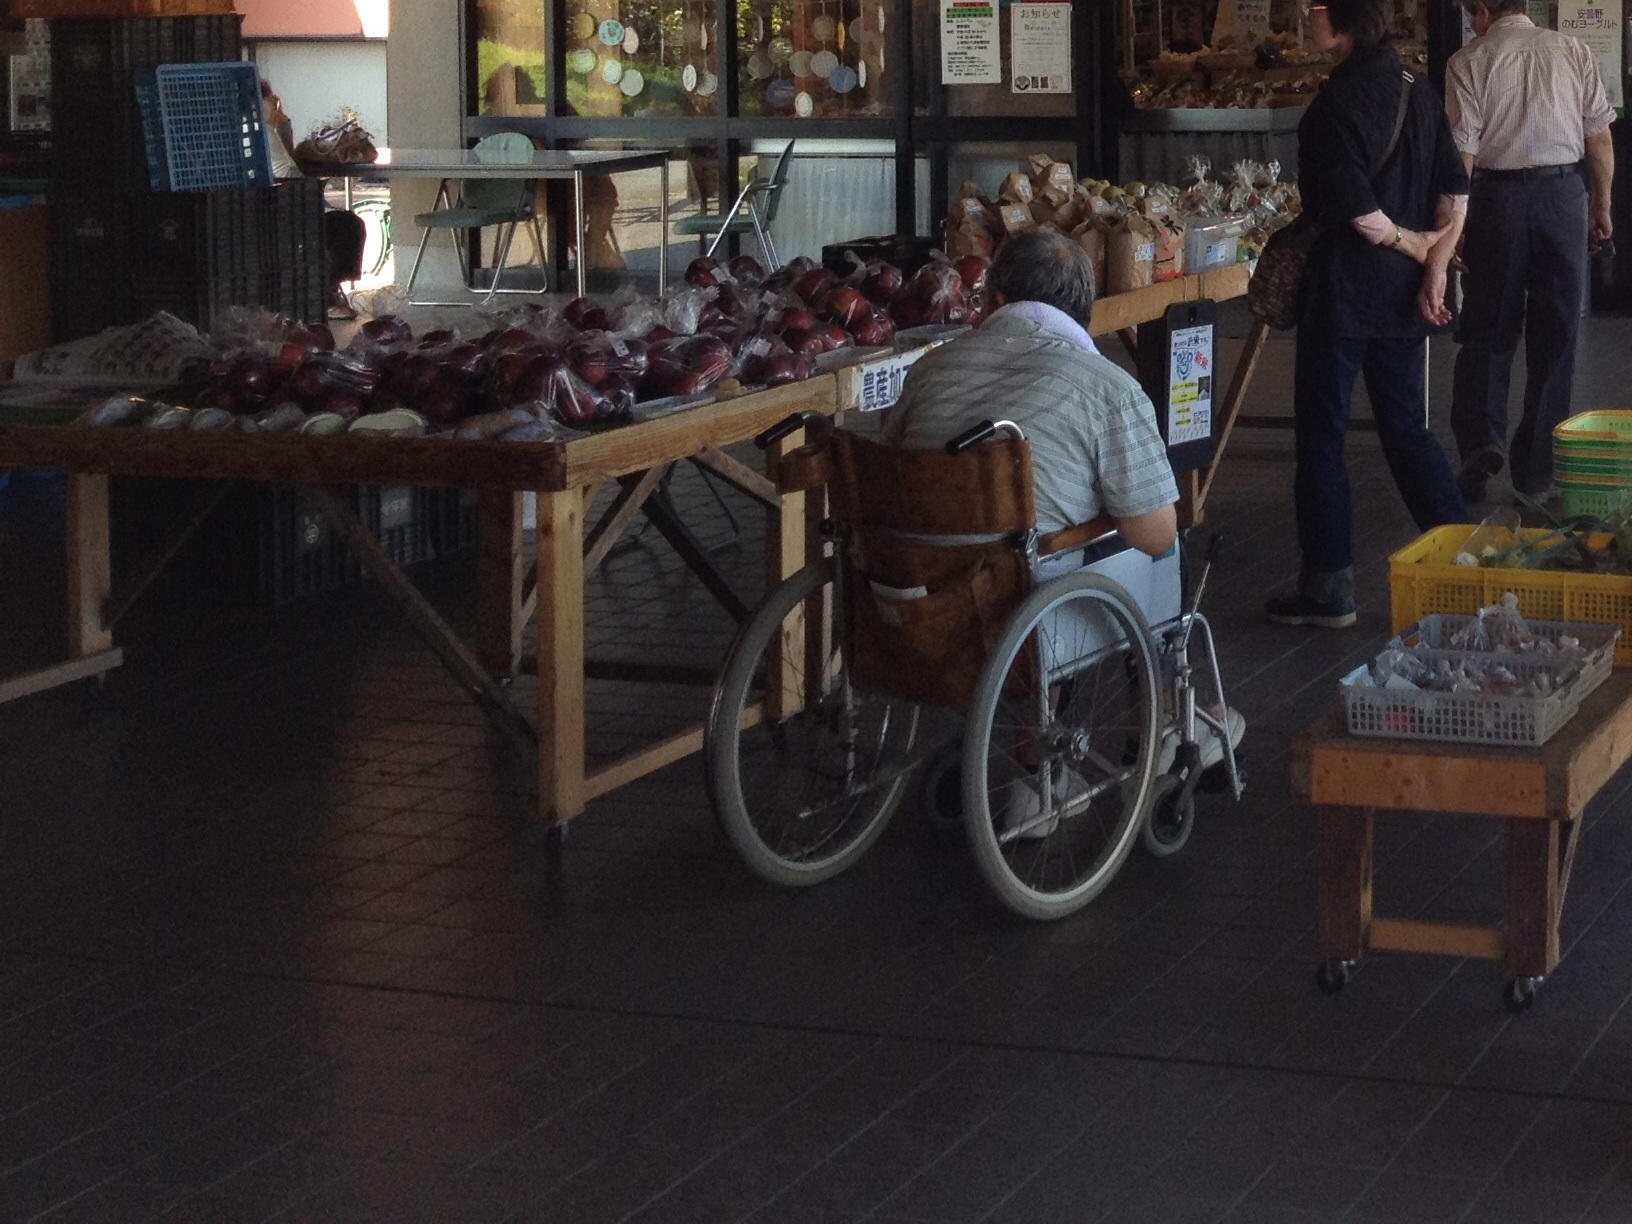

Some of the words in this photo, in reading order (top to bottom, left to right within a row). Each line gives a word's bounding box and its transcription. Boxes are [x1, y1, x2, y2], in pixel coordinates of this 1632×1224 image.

[1020, 8, 1061, 19] お知らせ
[1562, 19, 1618, 30] のむヨーグルト
